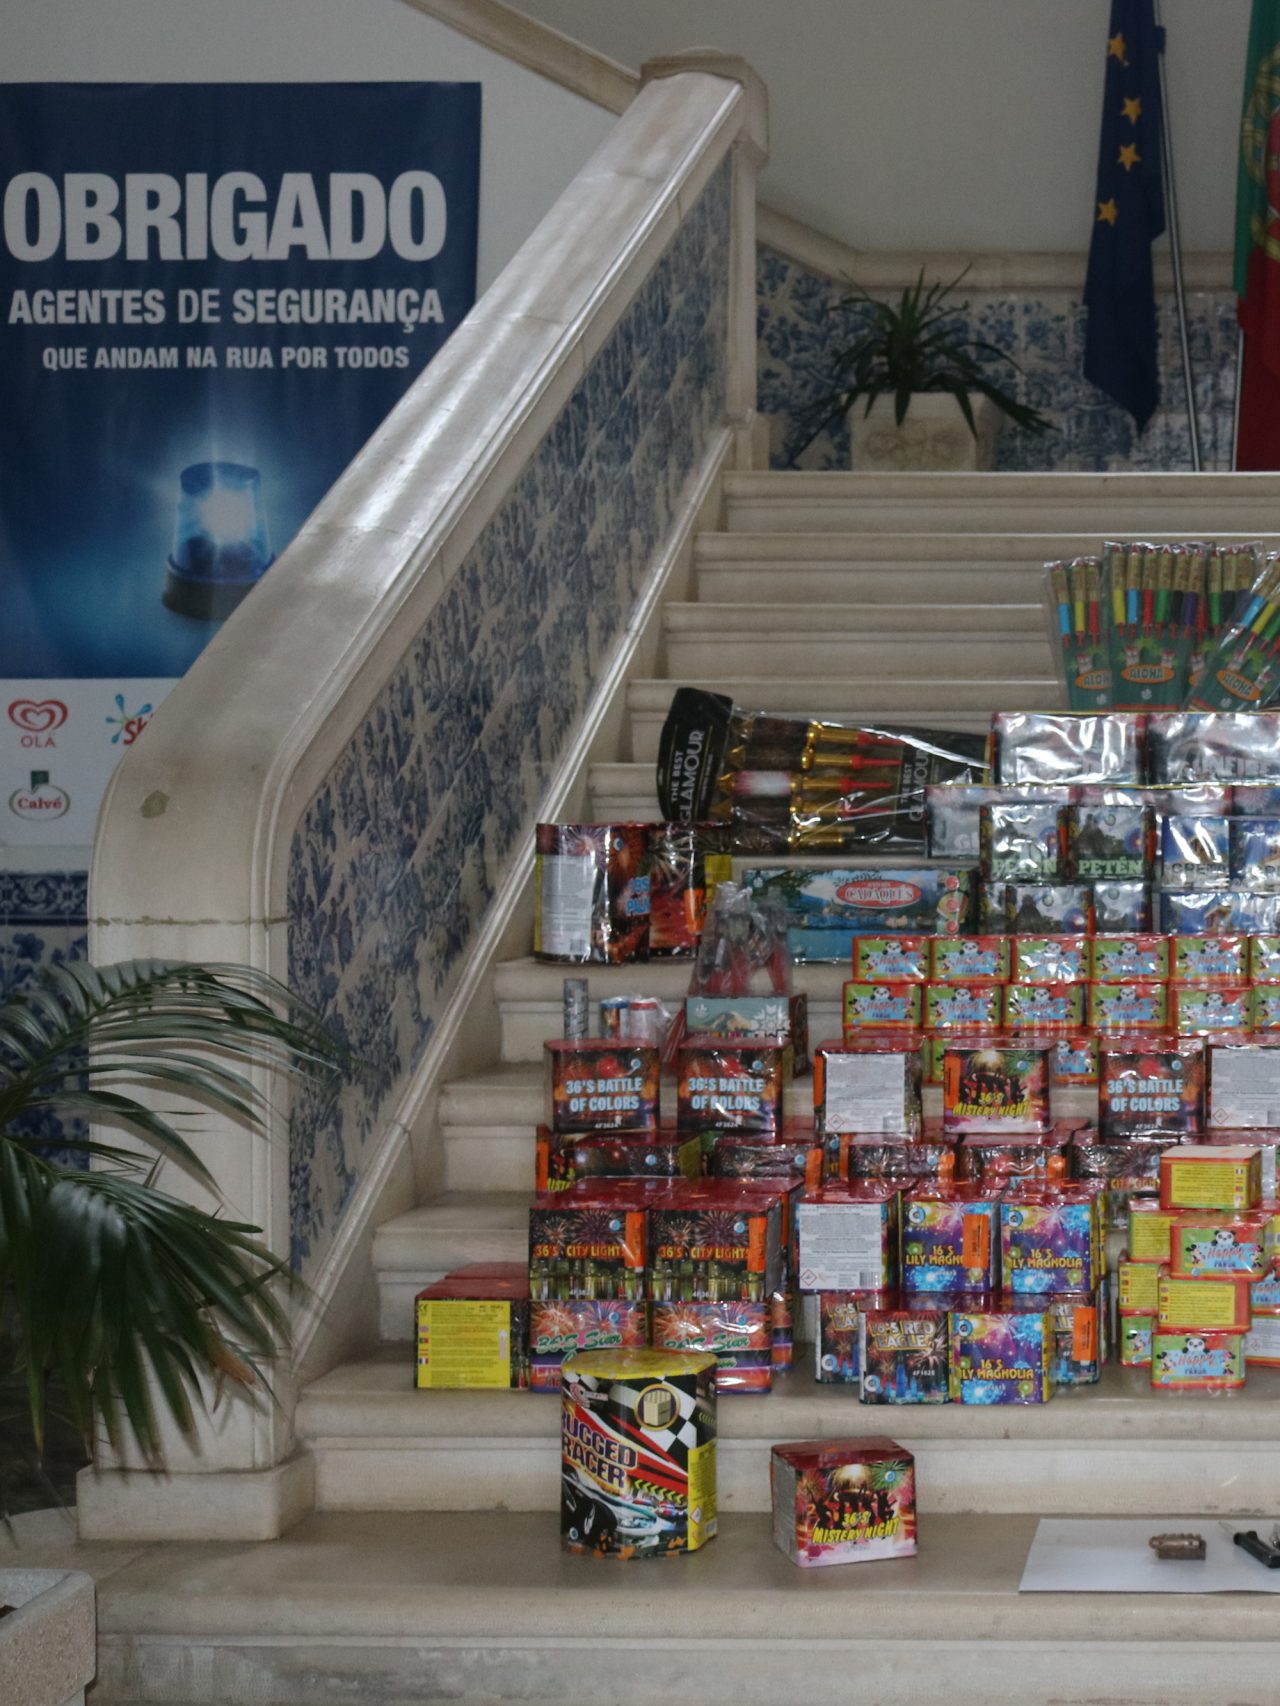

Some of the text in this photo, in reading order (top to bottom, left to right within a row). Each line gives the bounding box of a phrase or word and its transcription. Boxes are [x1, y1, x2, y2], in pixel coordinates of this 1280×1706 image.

[3, 170, 447, 262] OBRIGADO
[8, 288, 444, 333] AGENTES DE SEGURANÇA
[43, 346, 410, 370] QUE ANDAM NA RUA POR TODOS
[1083, 676, 1112, 687] ALOH
[1129, 668, 1165, 681] ALOHA
[1223, 675, 1255, 698] ALOHA
[671, 750, 684, 803] THE BEST
[679, 730, 705, 823] GLAMOUR
[18, 796, 63, 811] Calvé
[1078, 856, 1144, 875] PETÉN
[567, 1077, 642, 1094] 36'S BATTLE
[688, 1078, 765, 1092] 36'S BATTLE
[1107, 1079, 1184, 1094] 36'S BATTLE
[570, 1096, 640, 1112] OF COLORS
[692, 1096, 760, 1111] OF COLORS
[953, 1101, 1030, 1117] MISTERY NIGHT
[1111, 1097, 1180, 1112] OF COLORS
[566, 1245, 589, 1257] CITY
[690, 1246, 713, 1258] CITY
[906, 1255, 925, 1266] LILY
[1028, 1258, 1083, 1269] MAGNOLIA
[877, 1334, 928, 1349] EAGLE
[977, 1368, 1034, 1380] MAGNOLIA
[561, 1434, 627, 1489] RACER
[812, 1517, 900, 1544] MISTERY NIGHT
